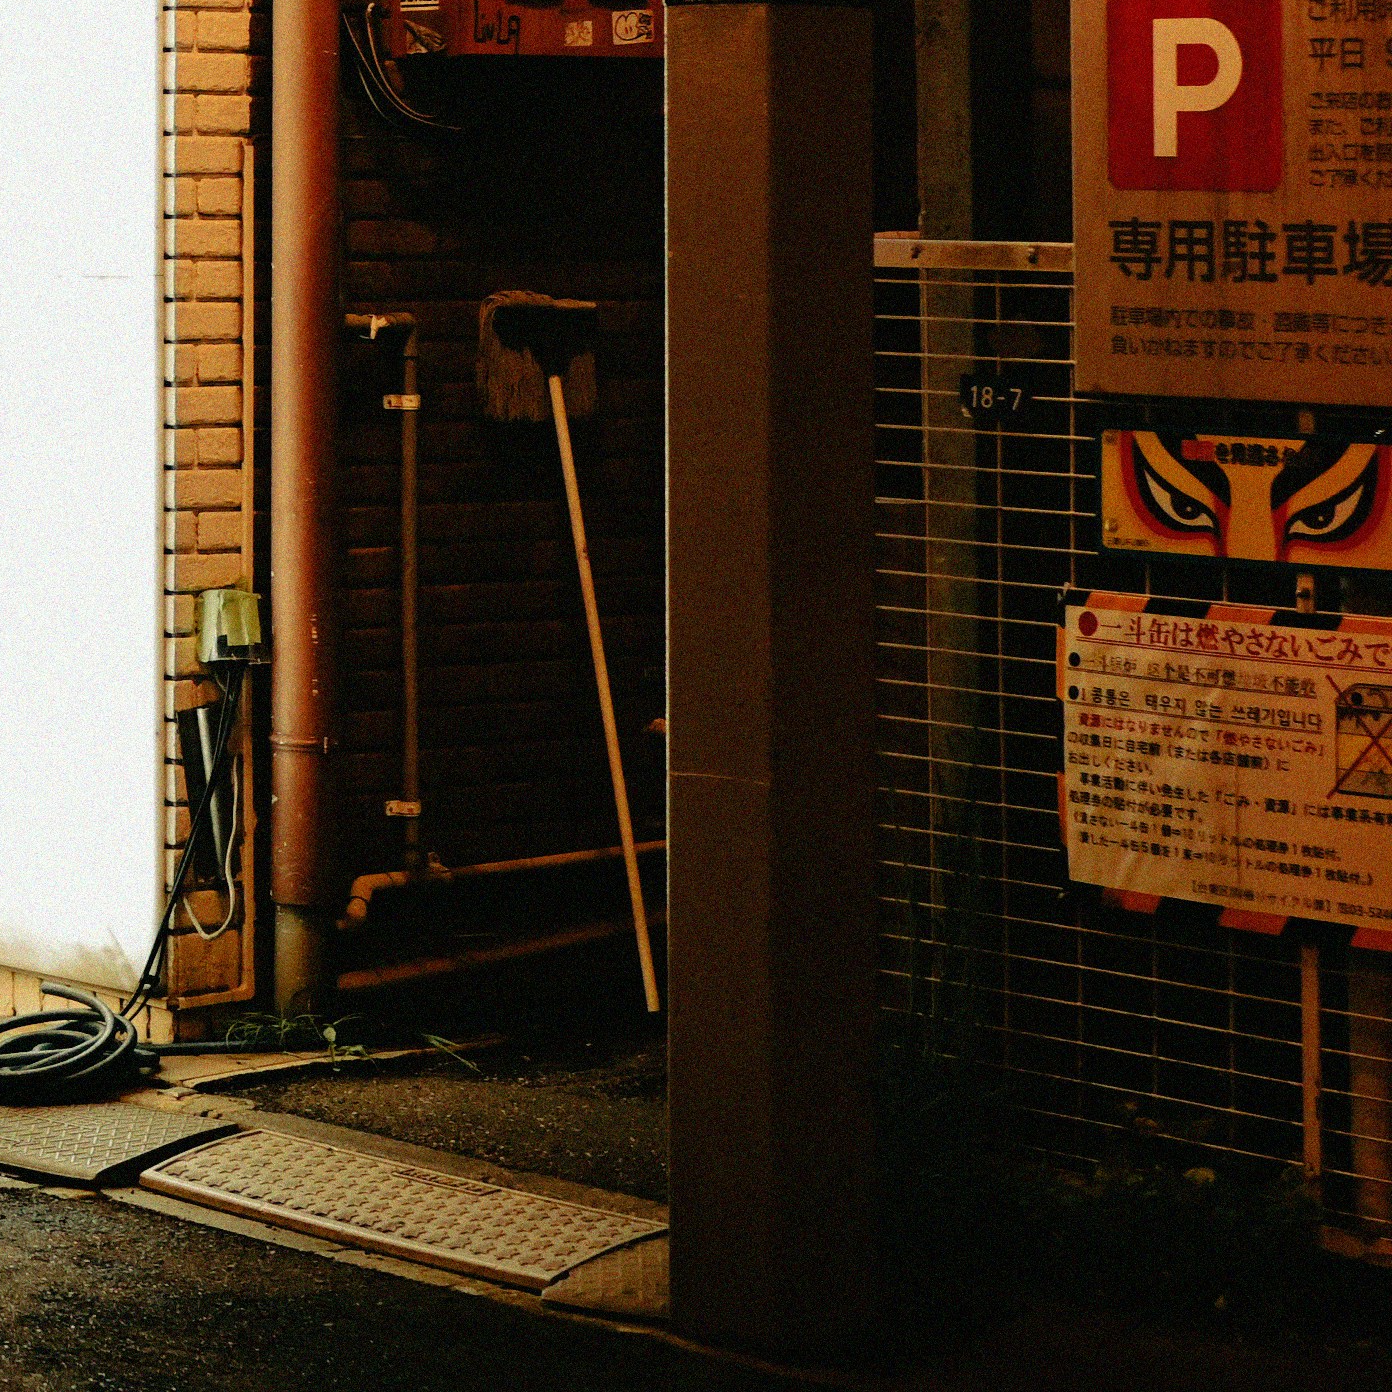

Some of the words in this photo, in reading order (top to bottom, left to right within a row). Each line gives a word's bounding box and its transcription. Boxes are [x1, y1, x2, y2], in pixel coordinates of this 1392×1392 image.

[1153, 18, 1242, 157] P
[1108, 217, 1392, 287] 専用駐車場
[970, 384, 1022, 410] 18-7
